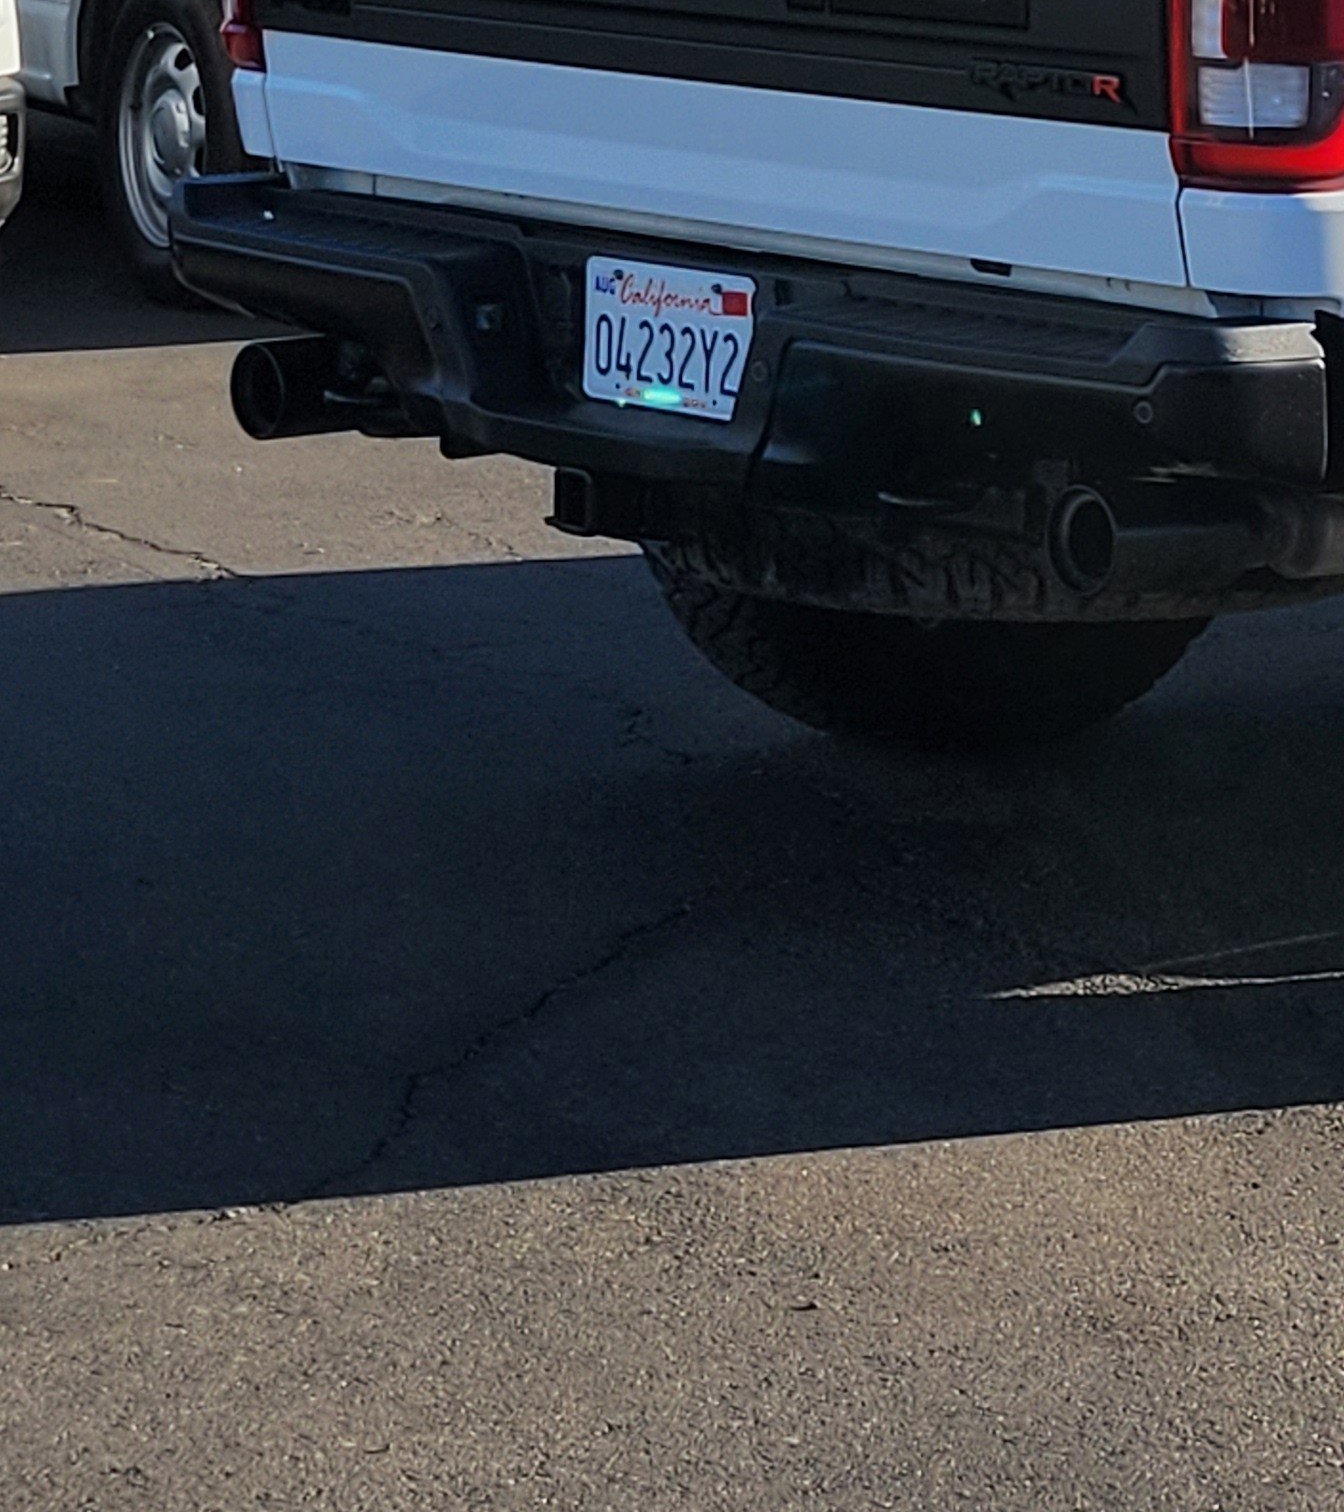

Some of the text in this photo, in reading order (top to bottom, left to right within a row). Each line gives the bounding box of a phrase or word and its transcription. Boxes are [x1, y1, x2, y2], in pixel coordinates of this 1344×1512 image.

[970, 56, 1138, 115] RAPTOR
[620, 274, 722, 317] California
[595, 312, 739, 397] 04232Y2
